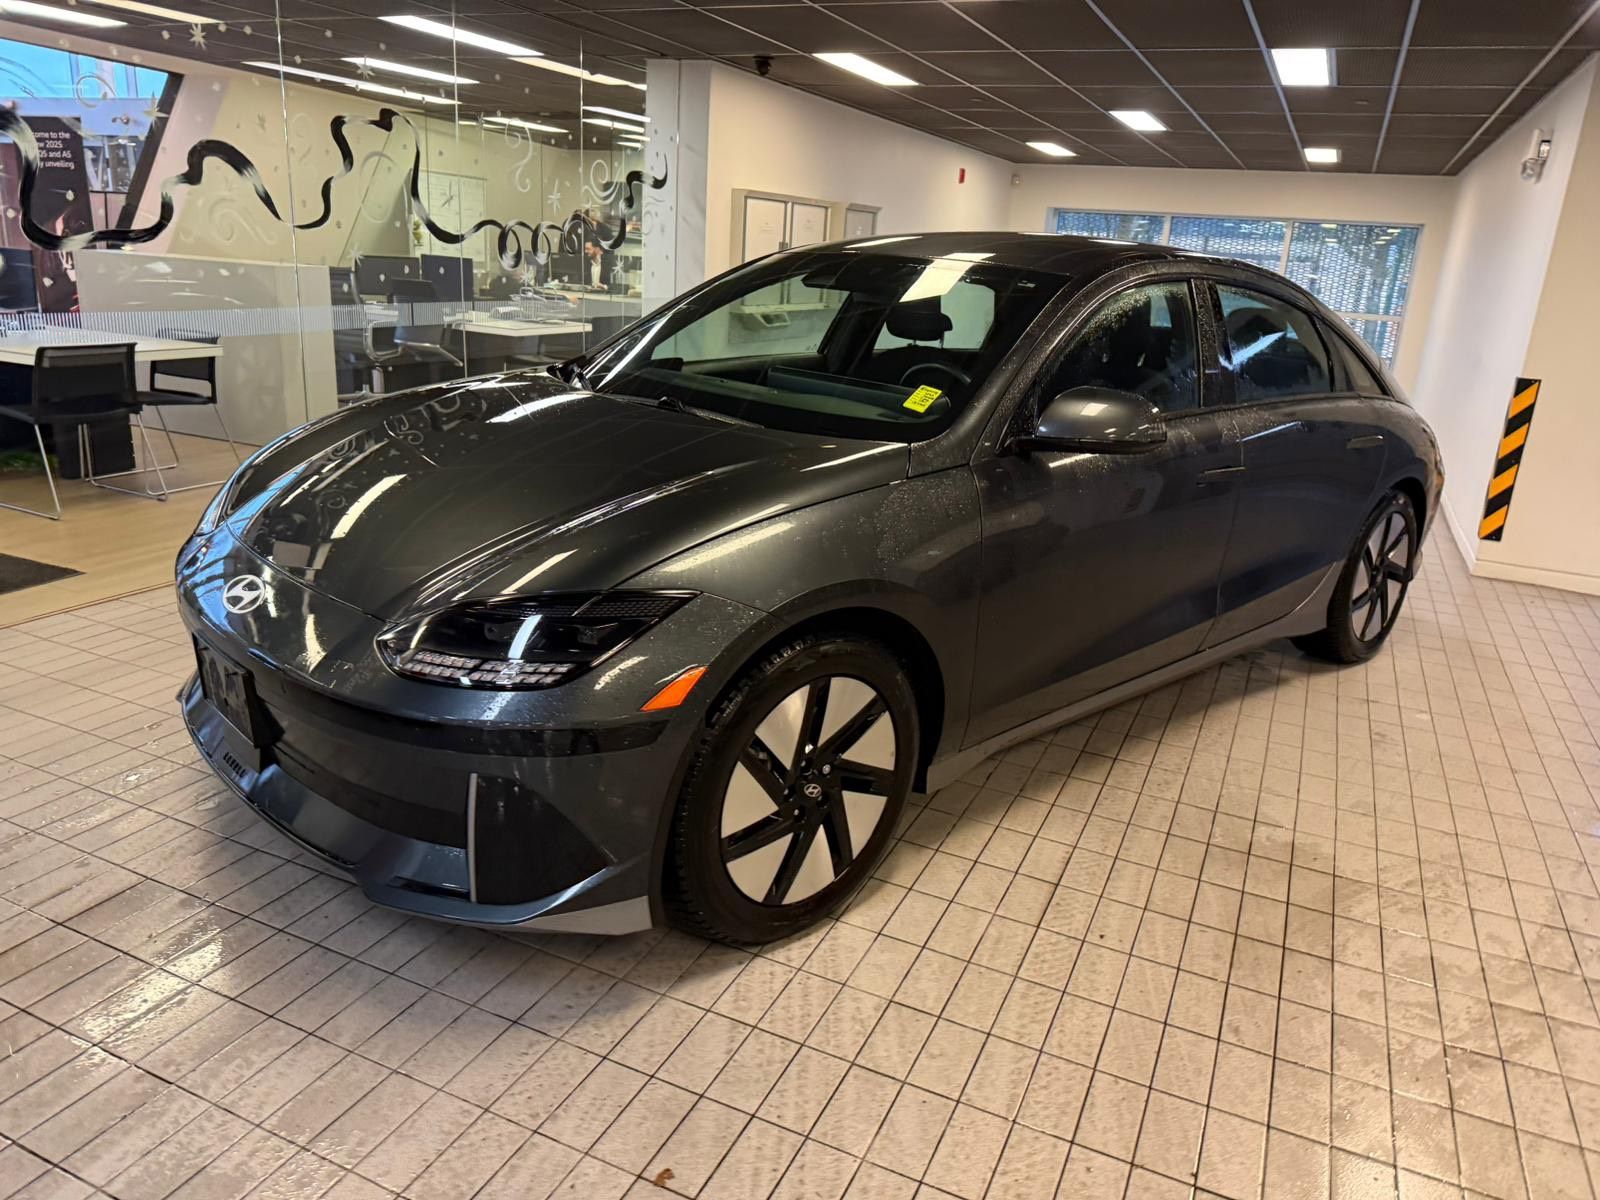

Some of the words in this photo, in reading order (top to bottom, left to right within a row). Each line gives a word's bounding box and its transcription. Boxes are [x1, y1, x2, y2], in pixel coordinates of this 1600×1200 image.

[59, 130, 71, 139] the
[45, 140, 63, 148] 2025
[48, 150, 61, 158] and
[45, 160, 75, 170] unveiling
